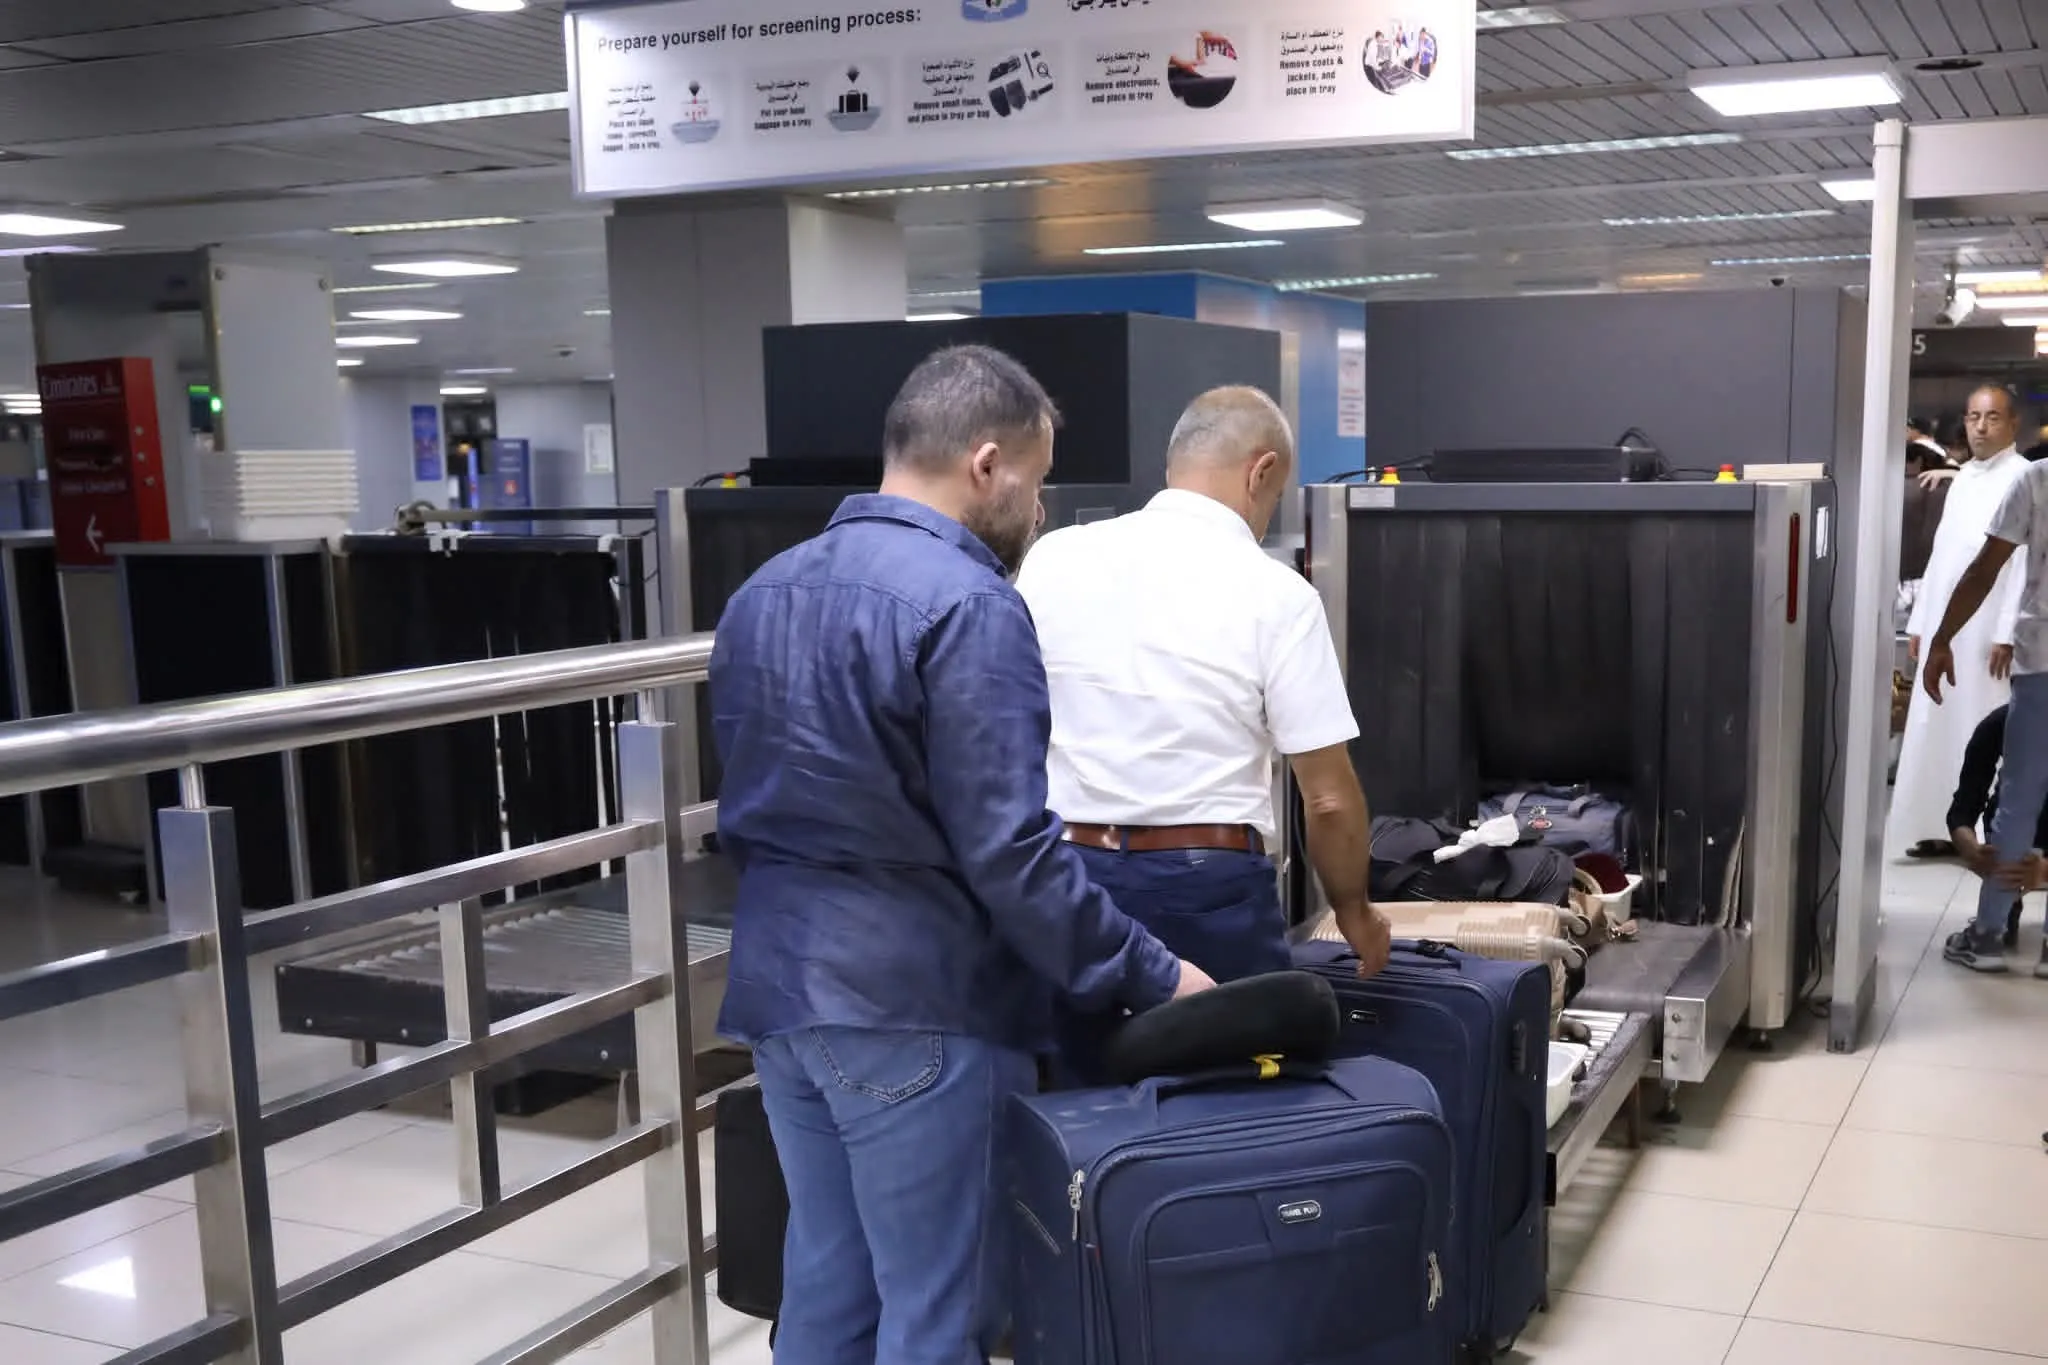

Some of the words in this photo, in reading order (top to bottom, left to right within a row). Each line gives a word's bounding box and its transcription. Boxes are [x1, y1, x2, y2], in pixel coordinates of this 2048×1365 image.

[598, 34, 657, 53] Prepare
[662, 24, 727, 50] yourself
[732, 23, 753, 39] for
[759, 14, 841, 37] screening
[846, 8, 922, 34] process:
[1280, 59, 1310, 69] Remove
[1312, 56, 1335, 67] coats
[1337, 55, 1344, 65] &
[1321, 70, 1336, 80] and
[1085, 81, 1113, 91] Remove
[1286, 86, 1307, 96] place
[1309, 85, 1317, 95] in
[1319, 84, 1337, 95] tray
[1137, 91, 1153, 102] tray
[1913, 334, 1927, 355] 5
[41, 374, 98, 399] Emirates
